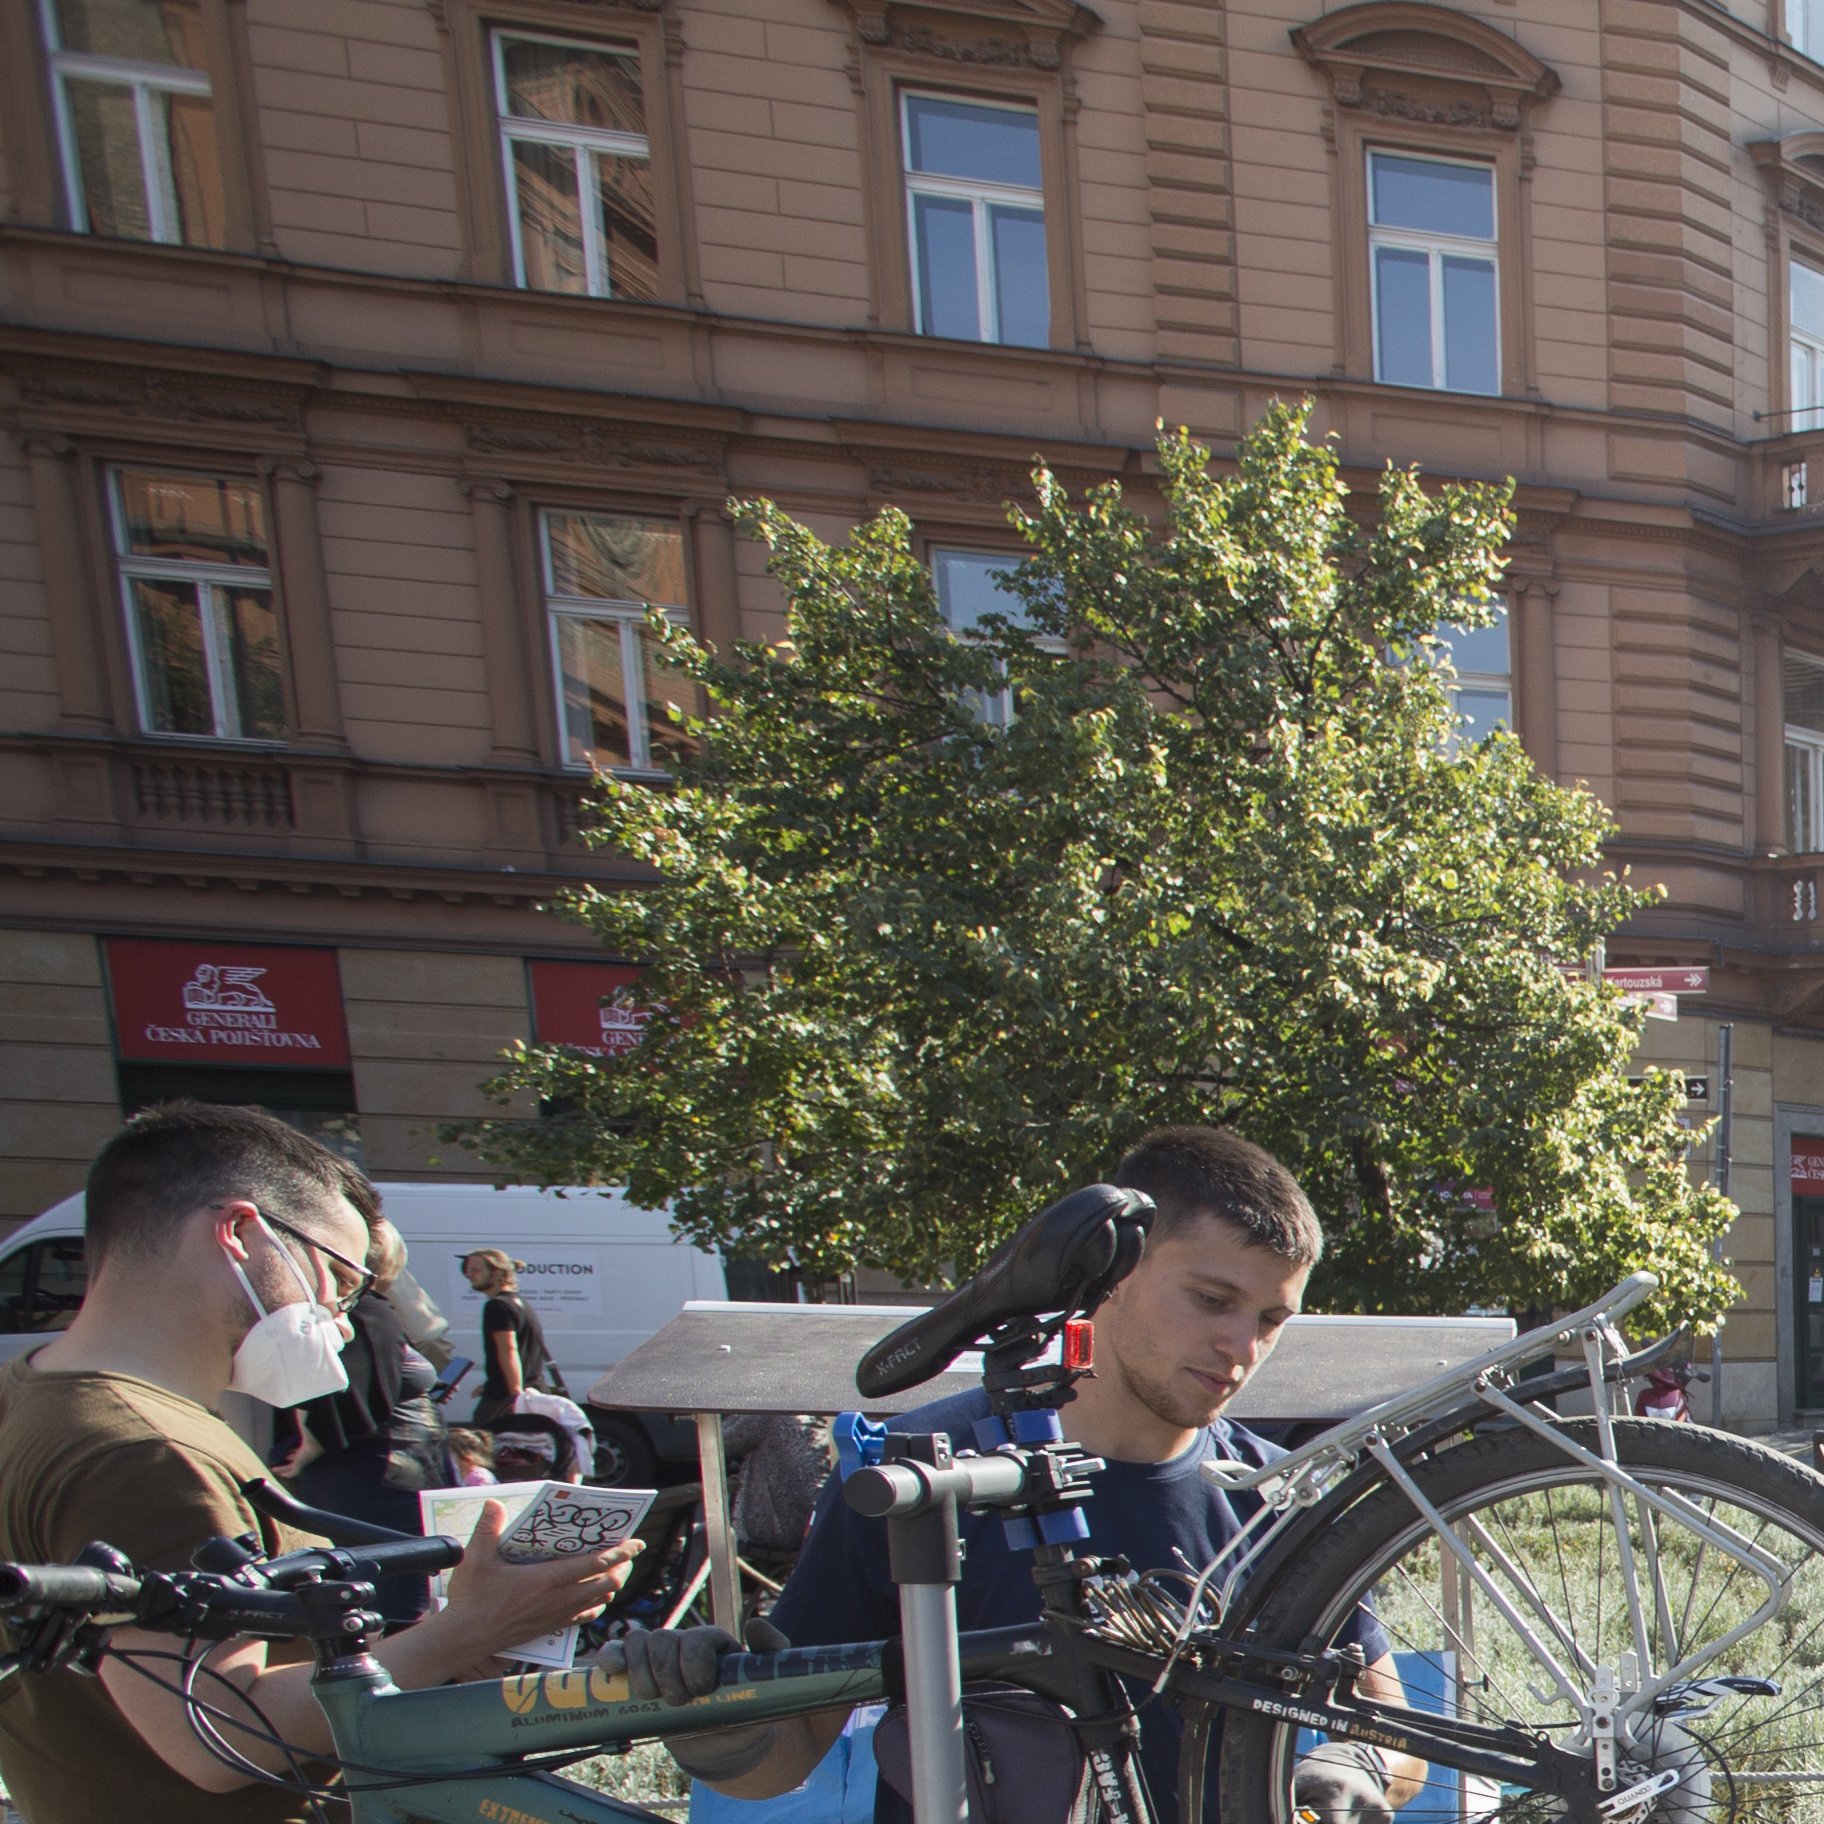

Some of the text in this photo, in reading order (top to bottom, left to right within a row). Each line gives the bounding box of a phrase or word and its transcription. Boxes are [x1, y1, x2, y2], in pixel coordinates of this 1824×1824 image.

[187, 1012, 277, 1029] GENERALI
[145, 1023, 322, 1049] ČESKÁ POJIŠŤOVNA
[875, 1338, 921, 1376] X-FACT
[717, 1688, 759, 1704] LINE
[511, 1701, 663, 1728] ALUMINUM 6061
[1252, 1699, 1409, 1750] DESIGNED IN AUSTRIA
